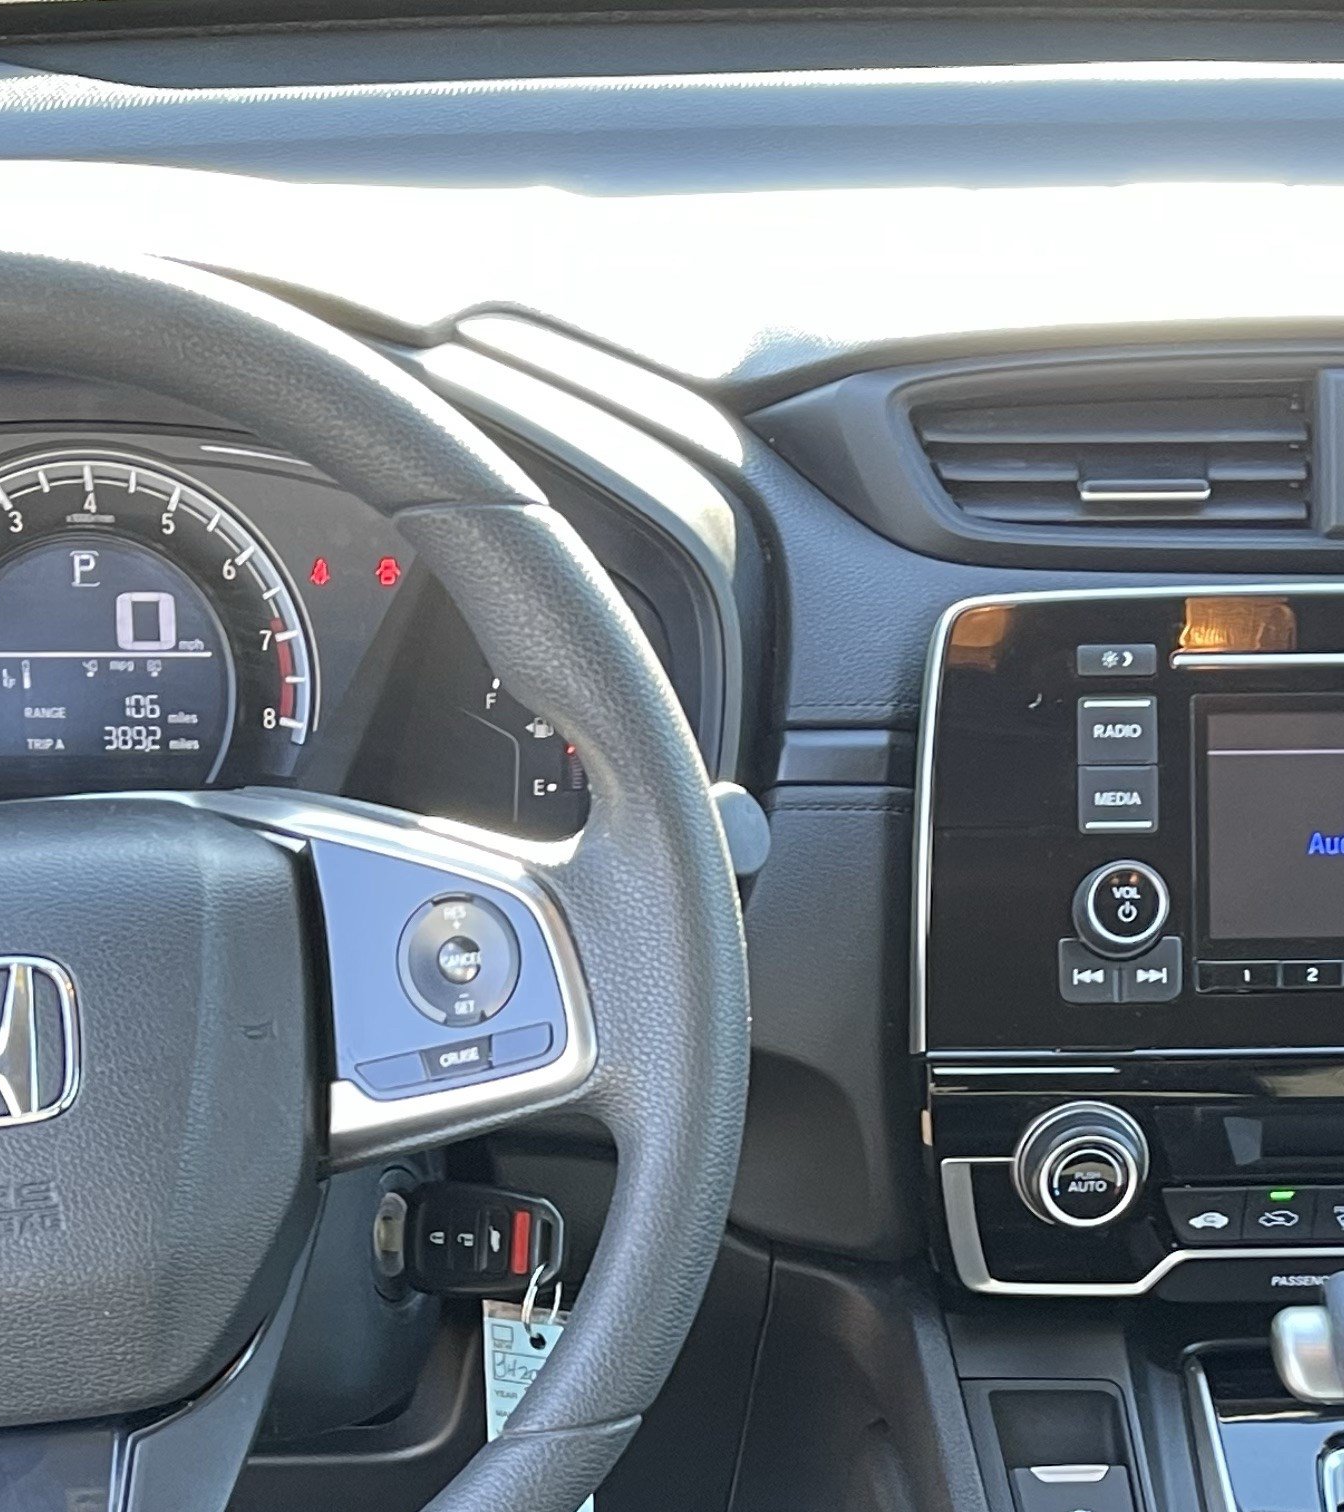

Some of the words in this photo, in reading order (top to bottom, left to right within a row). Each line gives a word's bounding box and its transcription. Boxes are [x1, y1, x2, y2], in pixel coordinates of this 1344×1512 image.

[83, 492, 97, 513] 4
[8, 511, 23, 533] 3
[161, 512, 176, 535] 5
[222, 562, 236, 580] 6
[116, 592, 177, 650] 0
[259, 630, 272, 651] 7
[486, 693, 497, 709] F
[24, 706, 67, 719] RANGE
[262, 706, 276, 729] 8
[1093, 724, 1143, 740] RADIO
[533, 779, 546, 797] E
[1094, 791, 1143, 807] MEDIA
[1112, 887, 1141, 900] VOL
[1243, 970, 1251, 982] 1
[1306, 967, 1319, 982] 2
[1067, 1180, 1108, 1193] AUTO
